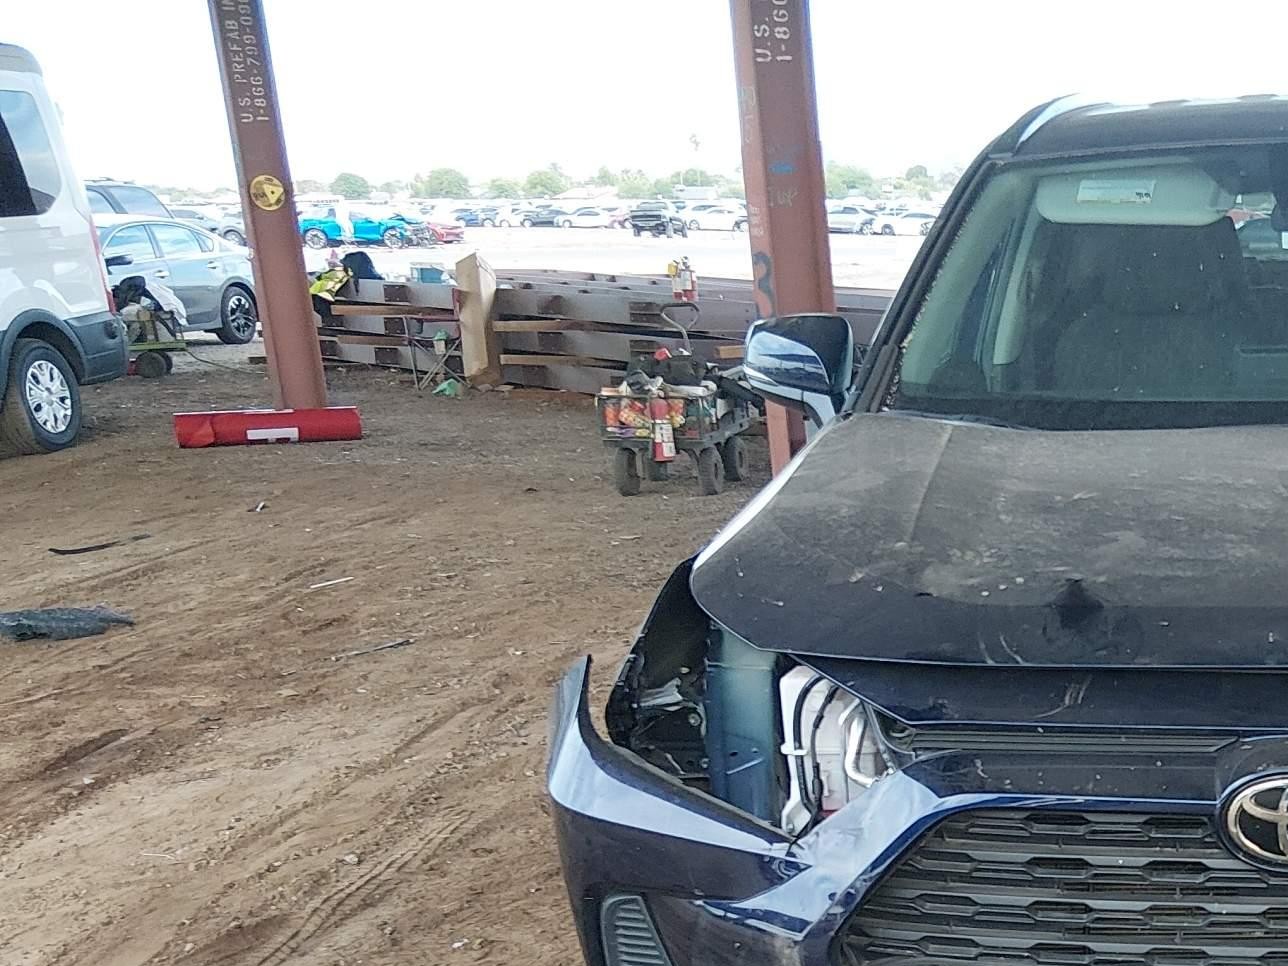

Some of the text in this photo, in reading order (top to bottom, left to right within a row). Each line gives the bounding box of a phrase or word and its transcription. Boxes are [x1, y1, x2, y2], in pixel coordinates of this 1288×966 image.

[224, 20, 248, 83] PREFAB
[238, 0, 270, 120] 1-866-799-09
[753, 17, 772, 62] U.S.
[239, 92, 254, 123] U.S.
